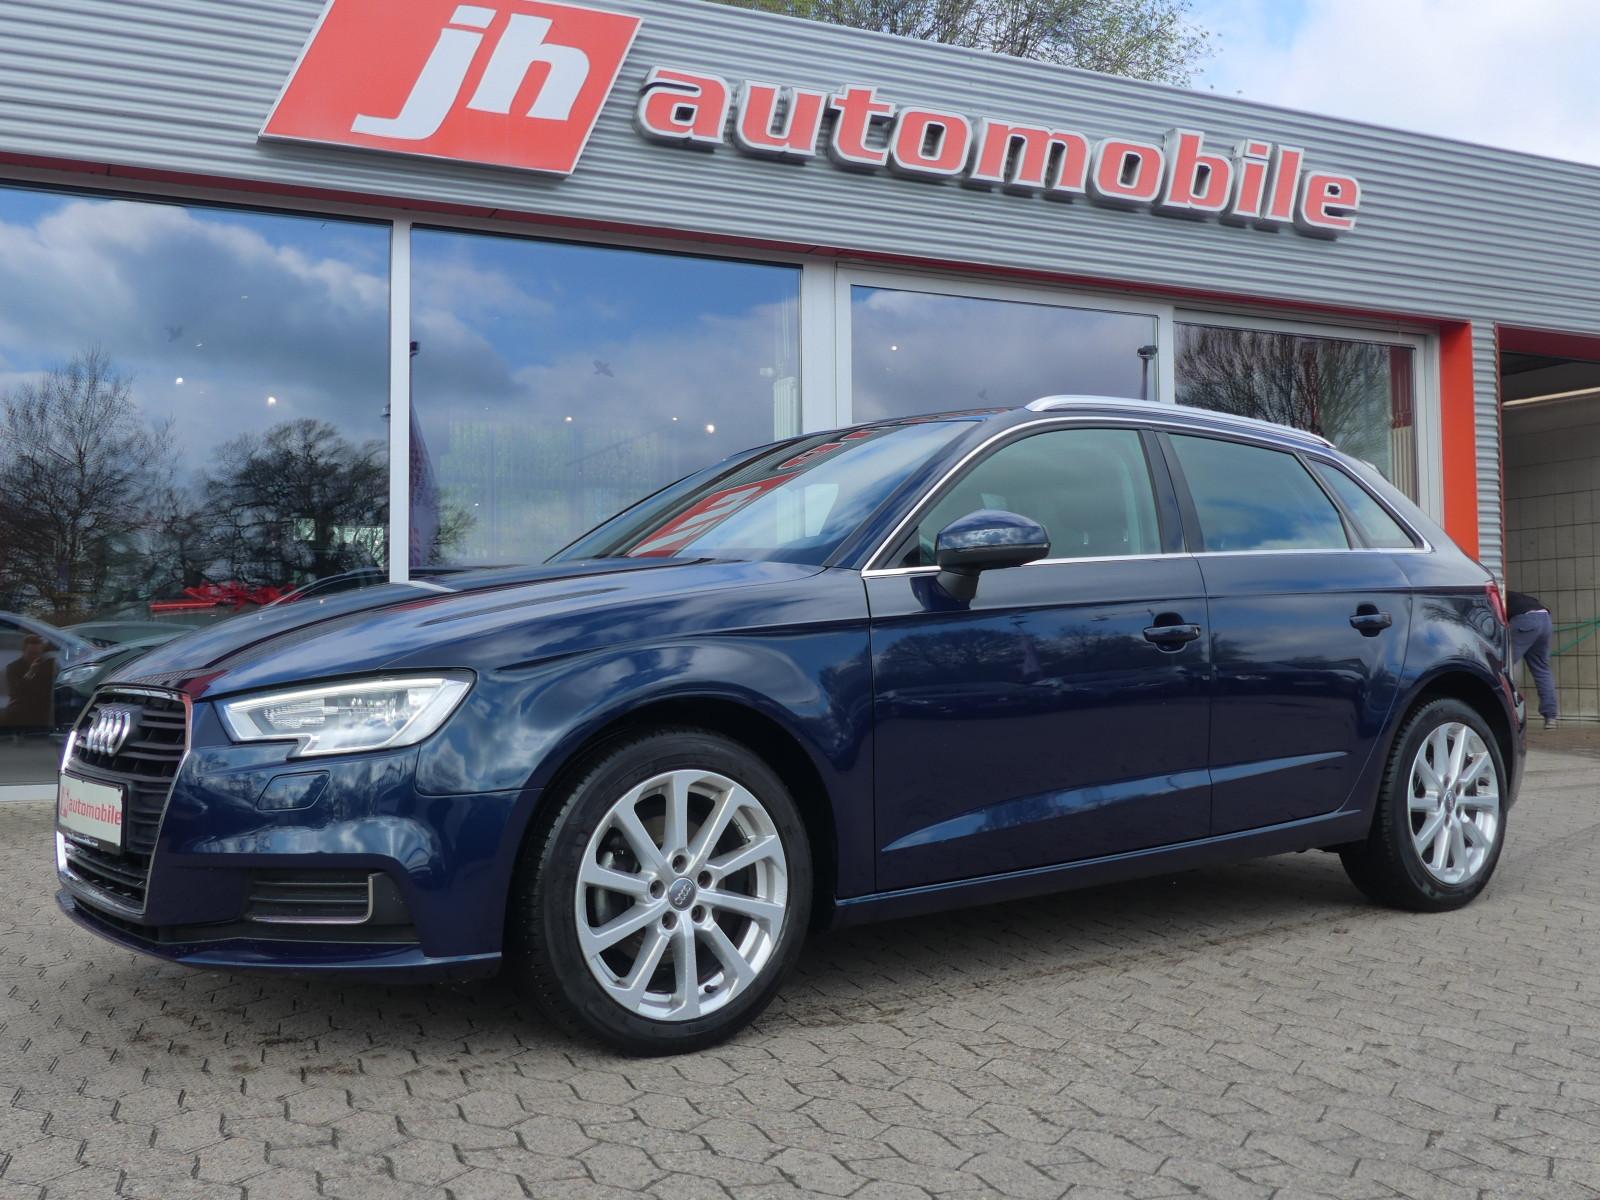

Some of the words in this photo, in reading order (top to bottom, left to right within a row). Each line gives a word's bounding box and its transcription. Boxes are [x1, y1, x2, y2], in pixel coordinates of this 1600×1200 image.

[351, 5, 590, 141] jh
[637, 65, 1362, 233] automobile
[69, 798, 122, 826] automobile
